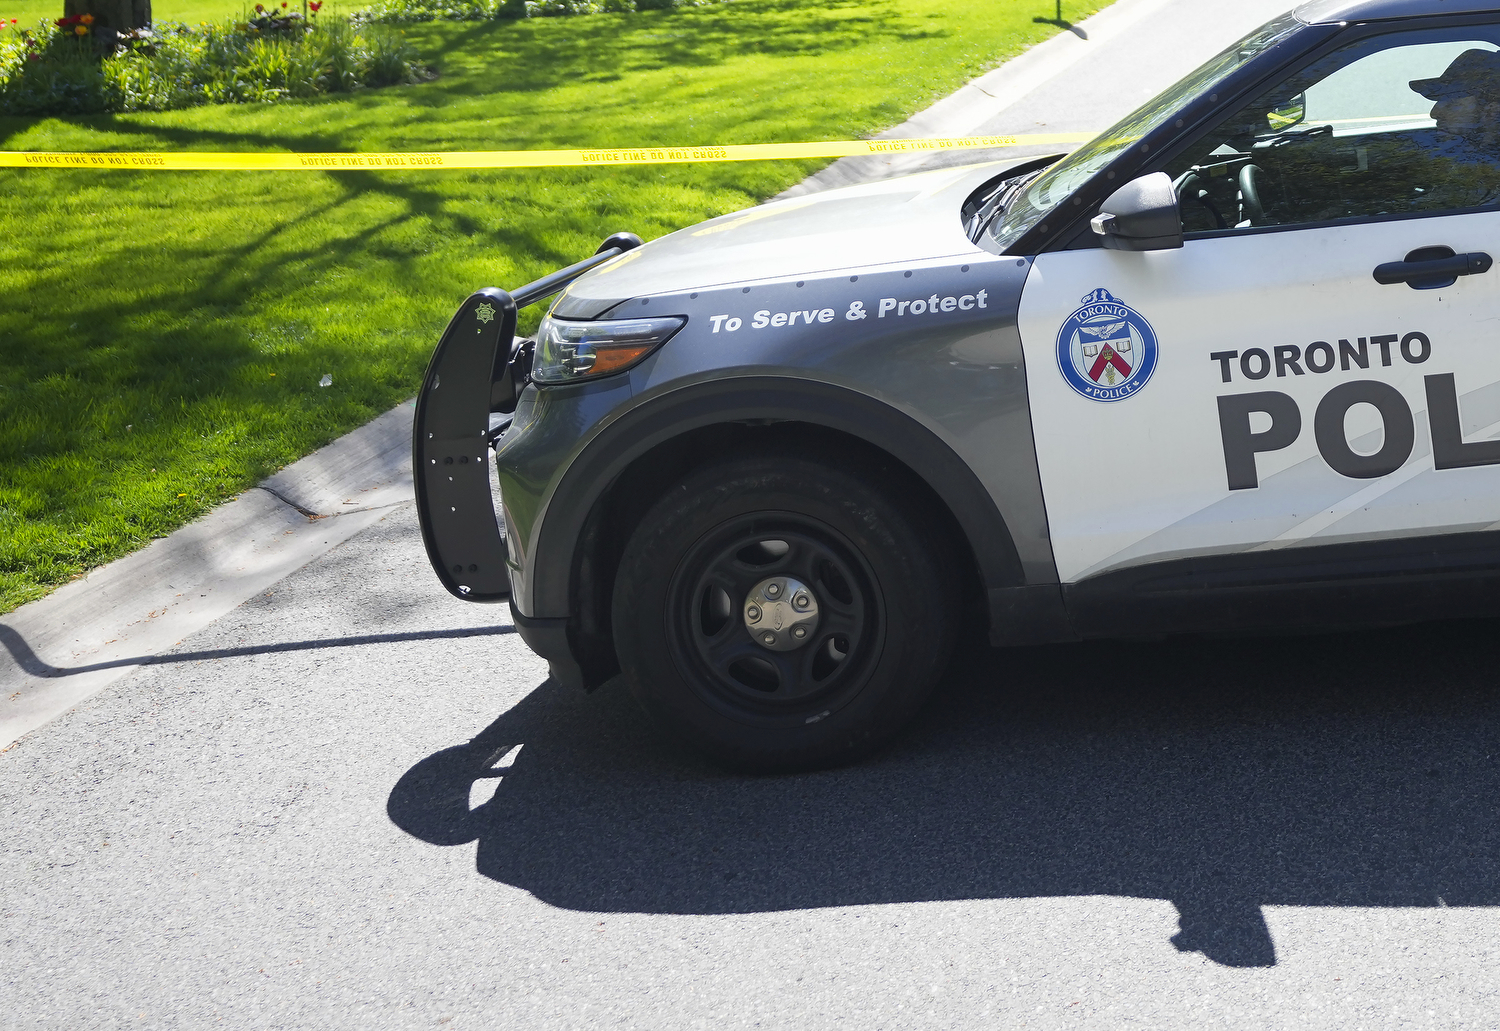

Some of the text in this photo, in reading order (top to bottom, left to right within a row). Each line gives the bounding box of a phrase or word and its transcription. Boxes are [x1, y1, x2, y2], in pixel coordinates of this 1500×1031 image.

[709, 289, 988, 333] To Serve & Protect
[1073, 306, 1127, 322] TORONTO
[1210, 331, 1431, 383] TORONTO
[1093, 385, 1133, 398] POLICE
